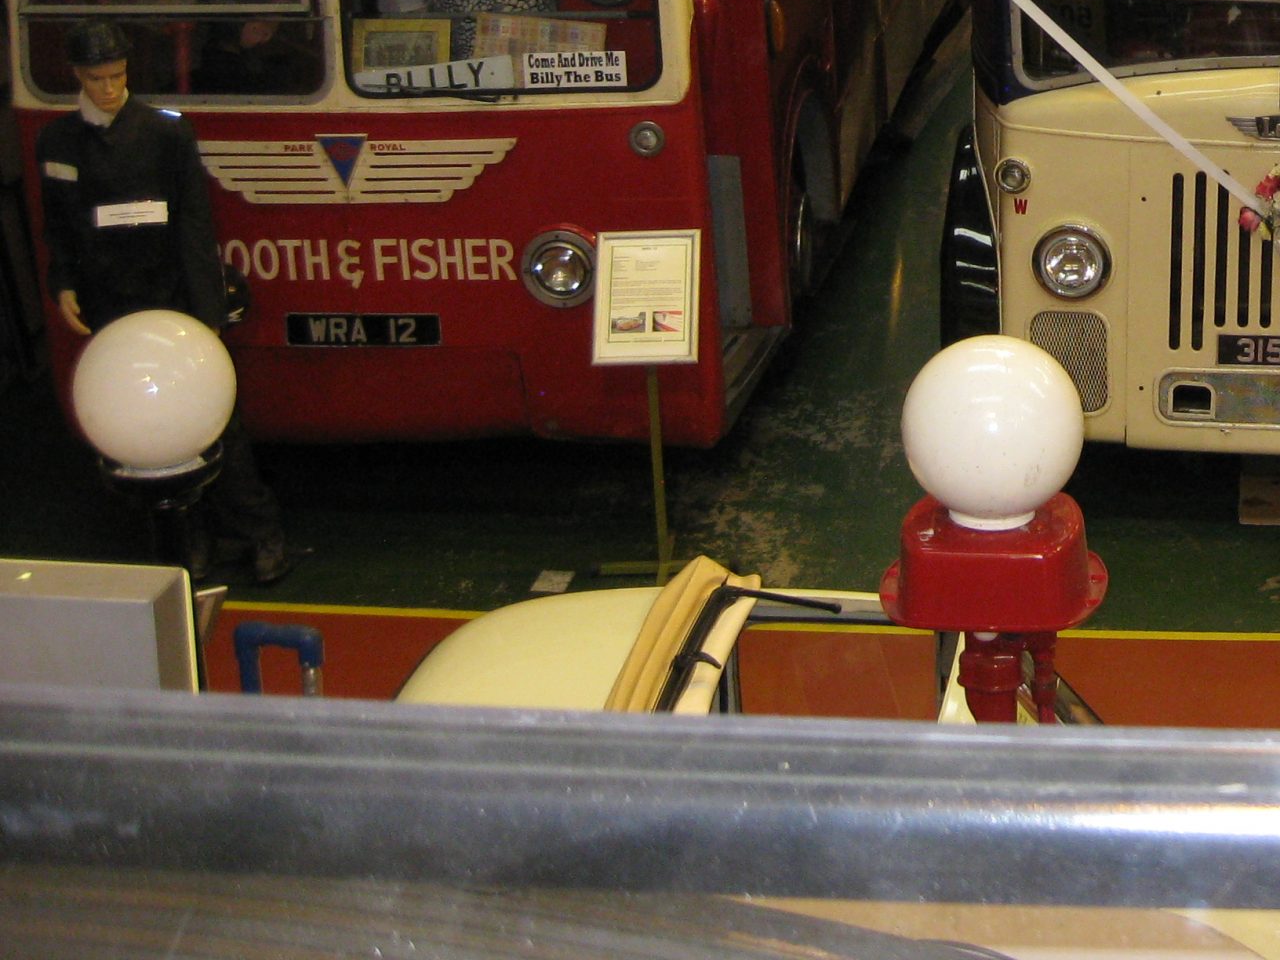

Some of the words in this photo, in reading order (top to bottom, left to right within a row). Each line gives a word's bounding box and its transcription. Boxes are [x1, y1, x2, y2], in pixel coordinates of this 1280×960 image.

[528, 54, 554, 69] Come
[557, 53, 576, 68] And
[578, 52, 604, 68] Drive
[605, 51, 619, 67] Me
[530, 71, 563, 87] Billy
[564, 71, 591, 84] The
[594, 70, 622, 83] Bus
[284, 144, 314, 153] PARK
[370, 143, 407, 152] ROYAL
[1014, 198, 1028, 215] W
[217, 239, 330, 281] OOTH
[373, 238, 517, 281] FISHER
[309, 318, 367, 343] WRA
[389, 318, 417, 343] 12
